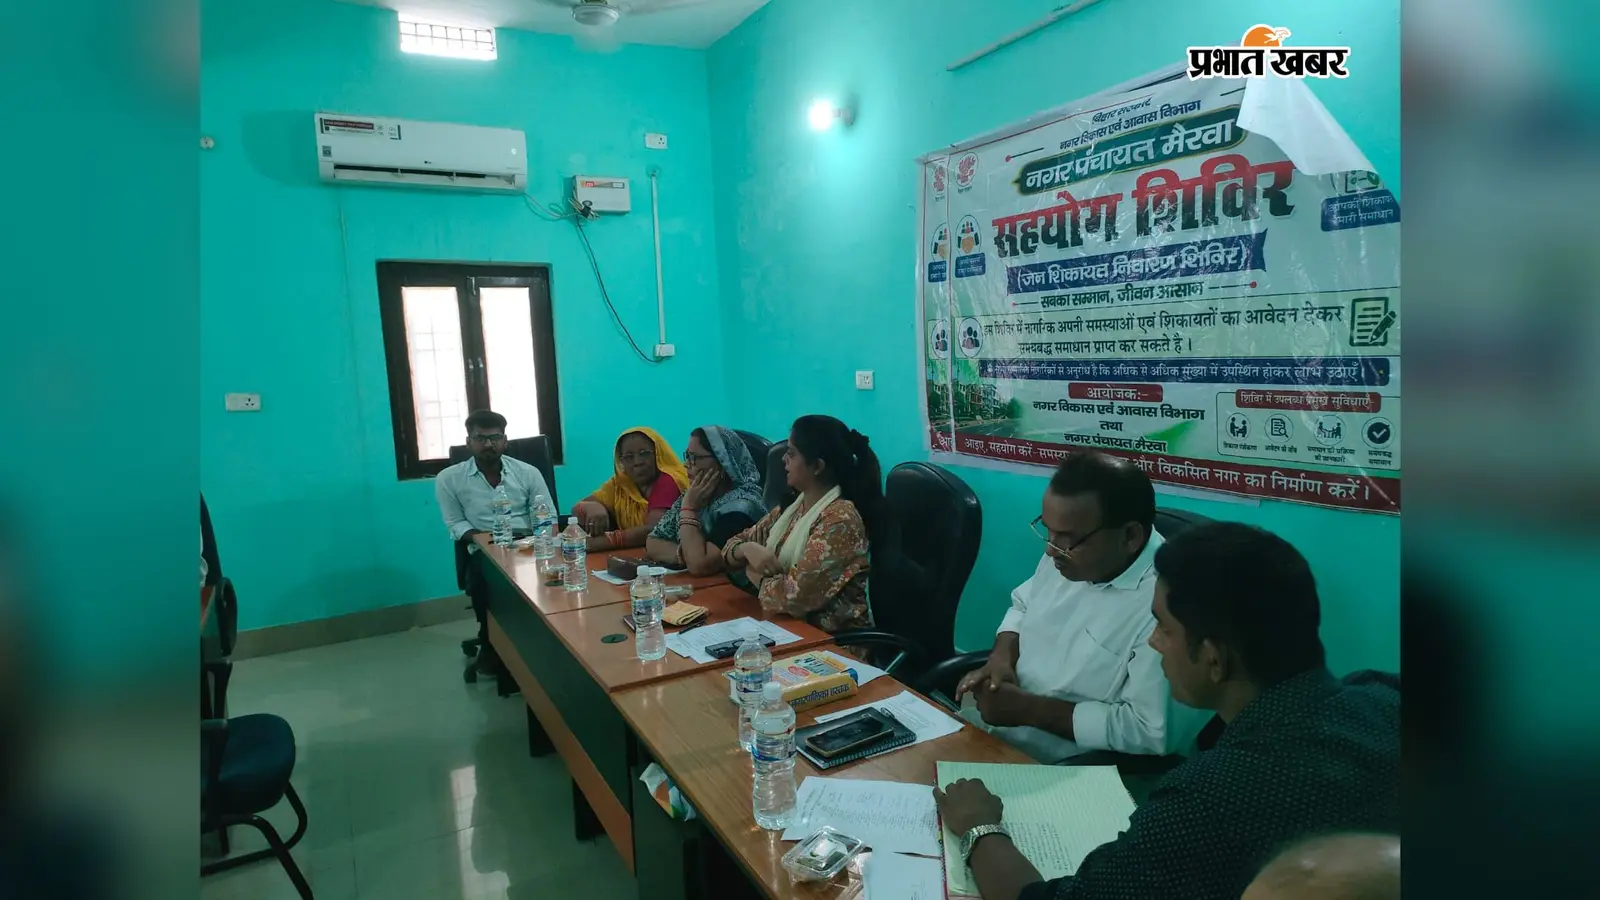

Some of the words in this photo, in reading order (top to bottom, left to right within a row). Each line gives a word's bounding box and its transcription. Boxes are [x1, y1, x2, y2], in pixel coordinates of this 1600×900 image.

[1060, 136, 1080, 150] नगर
[1081, 126, 1107, 145] विकास
[1108, 118, 1123, 134] एवं
[1123, 110, 1158, 130] आवास
[1160, 100, 1201, 120] विभाग
[1027, 161, 1074, 188] नगर
[1074, 147, 1156, 176] पंचायत
[1160, 118, 1235, 156] मैरवा
[992, 190, 1123, 258] सहयोग
[1131, 153, 1296, 237] शिविर
[1018, 272, 1045, 291] (जन
[1048, 262, 1108, 285] शिकायत
[1112, 253, 1176, 278] निवारण
[1180, 241, 1247, 268] शिविर)
[1040, 294, 1070, 308] सबका
[1072, 290, 1114, 308] सम्मान,
[1117, 283, 1154, 302] जीवन
[1156, 280, 1204, 297] आसान
[1025, 318, 1055, 334] नागरिक
[1058, 315, 1083, 334] अपनी
[1086, 312, 1135, 332] समस्याओं
[1137, 311, 1156, 334] एवं
[1159, 307, 1216, 331] शिकायतों
[1221, 309, 1241, 326] का
[1245, 303, 1299, 325] आवेदन
[1302, 301, 1345, 326] देकर
[1054, 341, 1091, 354] समाधान
[1093, 340, 1115, 354] प्राप्त
[1118, 339, 1136, 353] कर
[1140, 333, 1170, 352] सकते
[1058, 363, 1065, 375] से
[1066, 364, 1091, 379] अनुरोध
[1092, 363, 1098, 376] है
[1099, 363, 1110, 376] कि
[1113, 364, 1139, 377] अधिक
[1140, 363, 1148, 376] से
[1150, 362, 1179, 377] अधिक
[1181, 362, 1207, 378] संख्या
[1209, 361, 1219, 377] में
[1222, 362, 1259, 378] उपस्थित
[1263, 362, 1291, 379] होकर
[1294, 365, 1321, 379] लाभ
[1033, 401, 1057, 411] नगर
[1058, 399, 1094, 414] विकास
[1096, 402, 1114, 417] एवं
[1117, 405, 1158, 418] आवास
[1160, 403, 1205, 420] विभाग
[1240, 391, 1263, 404] शिविर
[1099, 420, 1123, 432] तथा
[989, 439, 1016, 455] सहयोग
[1064, 433, 1092, 445] नगर
[1093, 433, 1132, 449] पंचायत
[1135, 437, 1167, 453] मैरवा
[1133, 454, 1155, 473] और
[1157, 458, 1210, 481] विकसित
[1213, 468, 1240, 486] नगर
[1243, 472, 1266, 489] का
[1270, 470, 1323, 495] निर्माण
